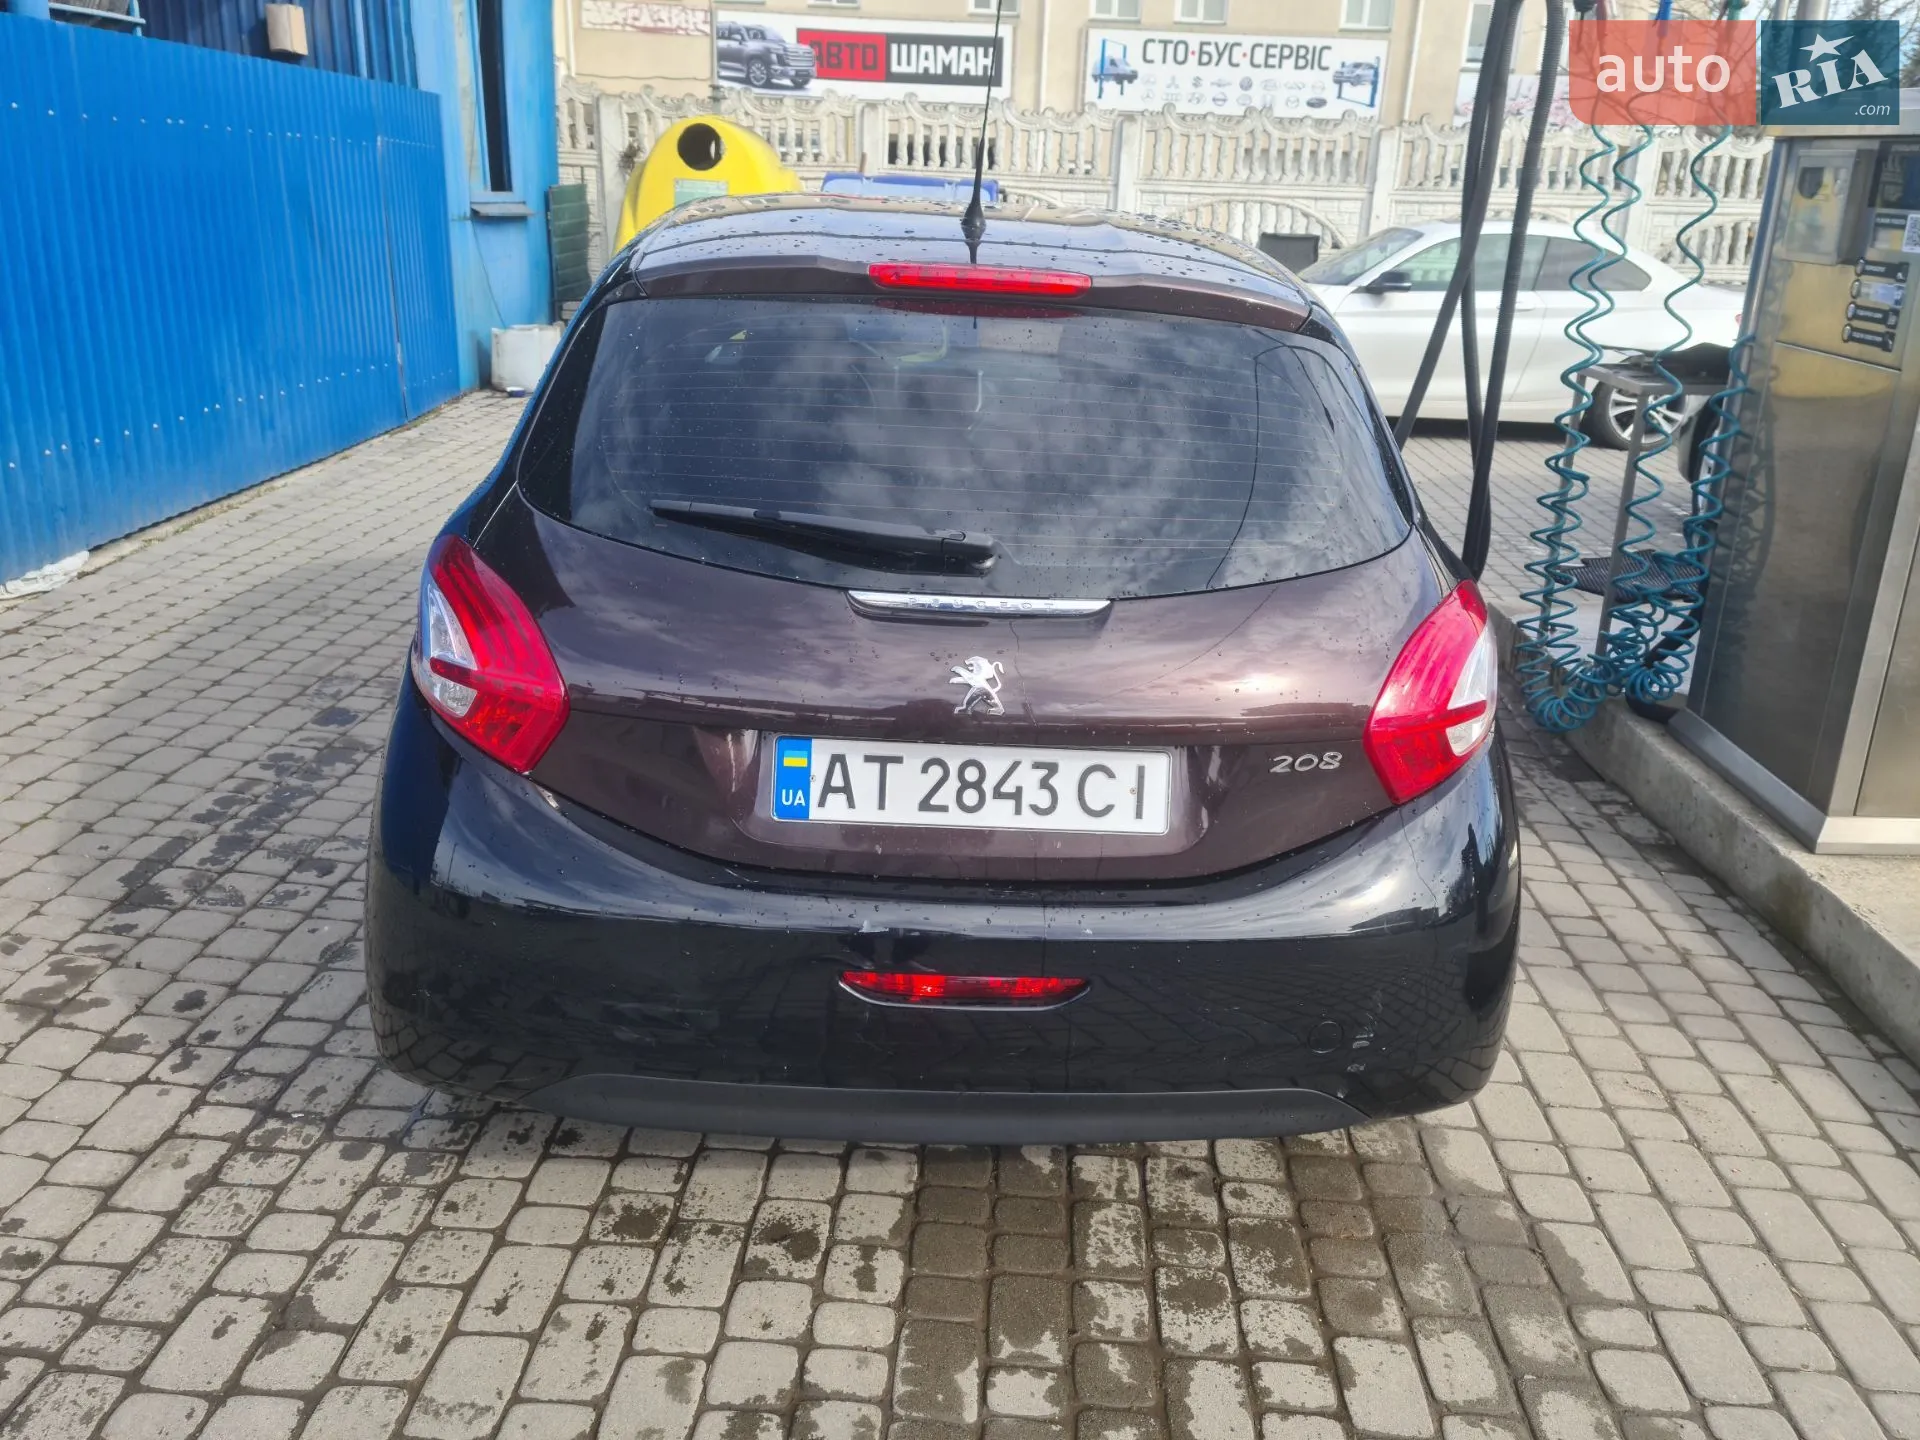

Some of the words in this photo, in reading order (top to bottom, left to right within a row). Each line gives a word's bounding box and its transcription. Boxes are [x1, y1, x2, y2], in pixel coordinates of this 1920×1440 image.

[808, 40, 878, 71] АВТО
[890, 42, 996, 77] ШАМАН
[1269, 751, 1343, 773] 208
[781, 788, 806, 807] UA
[817, 753, 904, 811] AT
[918, 757, 1060, 818] 2843
[1077, 764, 1146, 820] CI
